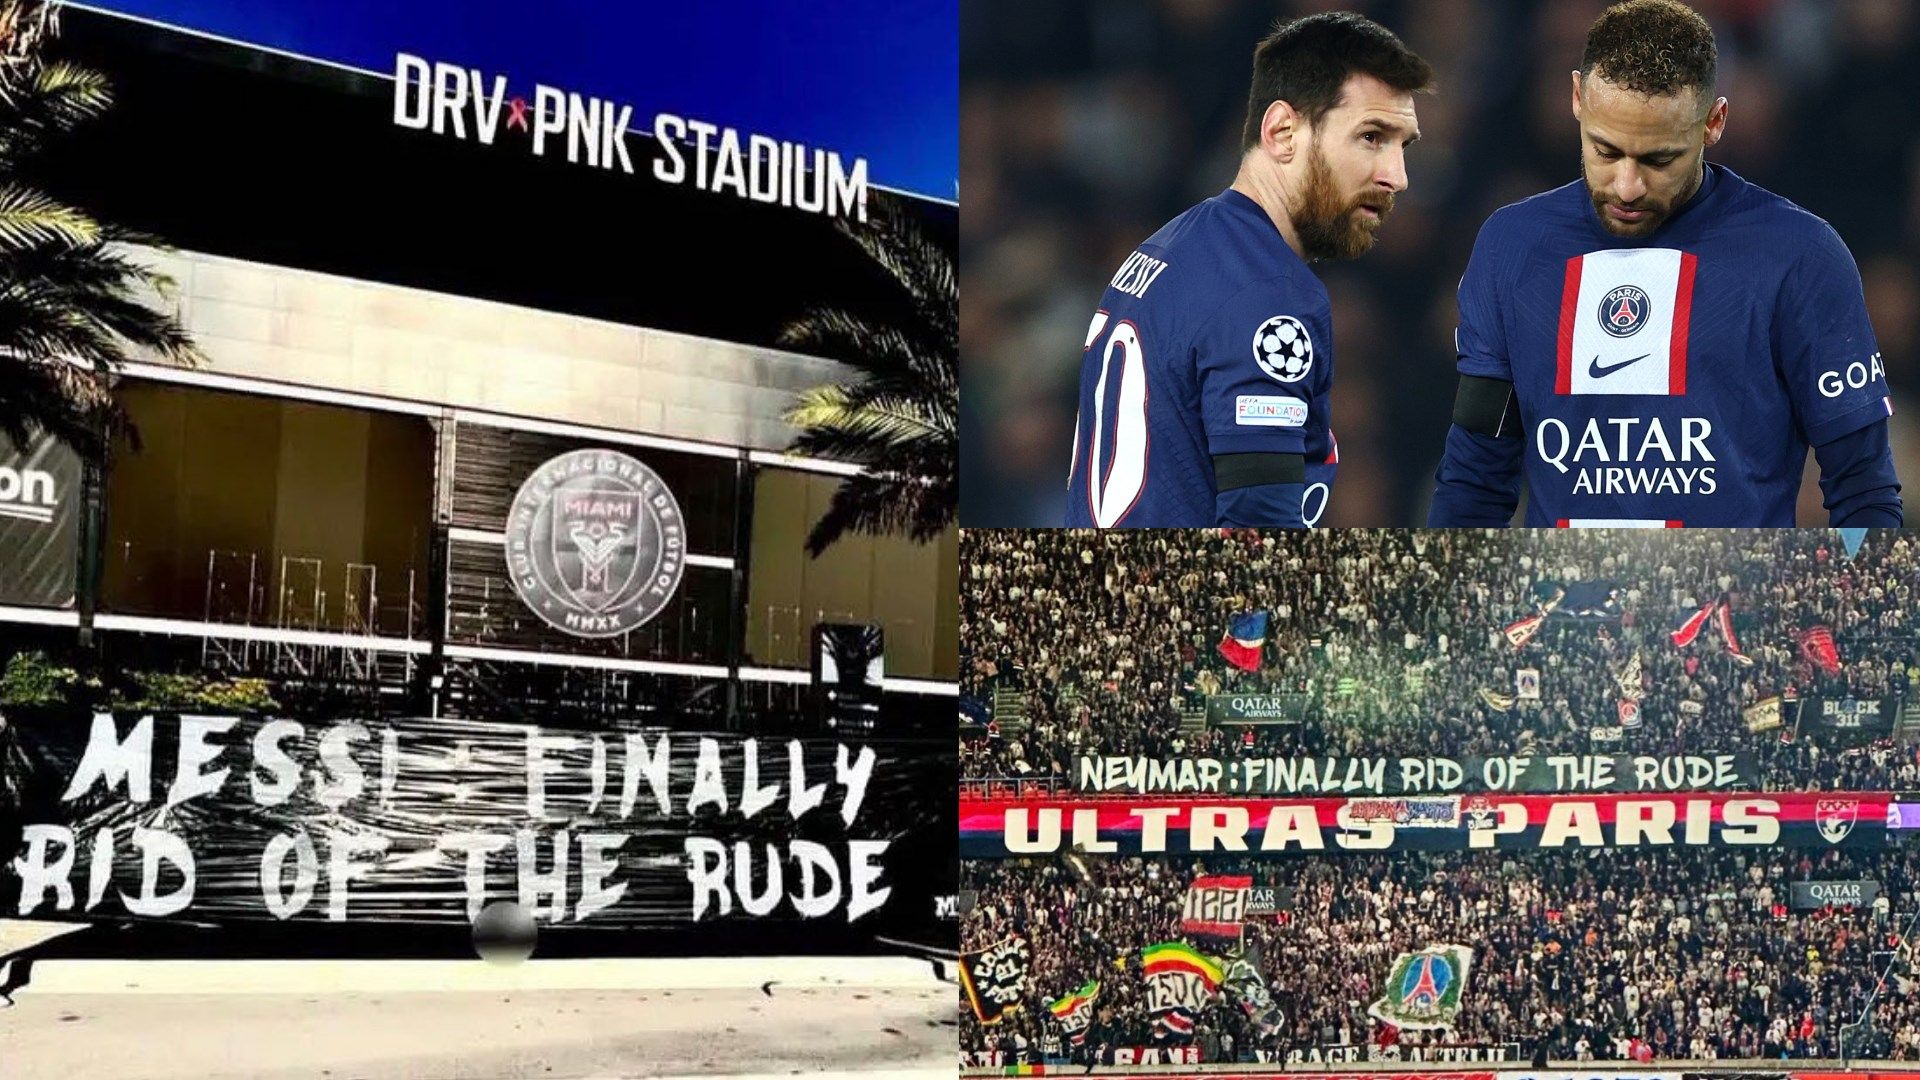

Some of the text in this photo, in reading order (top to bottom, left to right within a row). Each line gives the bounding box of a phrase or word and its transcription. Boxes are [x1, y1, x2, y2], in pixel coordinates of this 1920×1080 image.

[394, 53, 868, 223] DRV PNK STADIUM
[1110, 251, 1168, 298] MESSI
[1609, 289, 1643, 302] PARIS
[1240, 405, 1306, 416] FOUNDATION
[1536, 417, 1716, 474] QATAR
[1572, 468, 1717, 495] AIRWAYS
[565, 501, 632, 517] MIAMI
[565, 613, 622, 631] MMXX
[1232, 698, 1281, 712] QATAR
[1244, 710, 1282, 718] AIRWAYS
[1836, 714, 1860, 727] 311
[61, 712, 400, 812] MESSI
[526, 726, 876, 829] FINALLY
[1400, 757, 1463, 792] RID
[1483, 756, 1530, 790] OF
[1547, 755, 1616, 790] THE
[1634, 755, 1739, 789] RUDE
[1004, 803, 1395, 853] ULTRAS
[1469, 799, 1781, 848] PARIS
[14, 823, 893, 924] RID OF THE RUDE
[1810, 884, 1860, 900] QATAR
